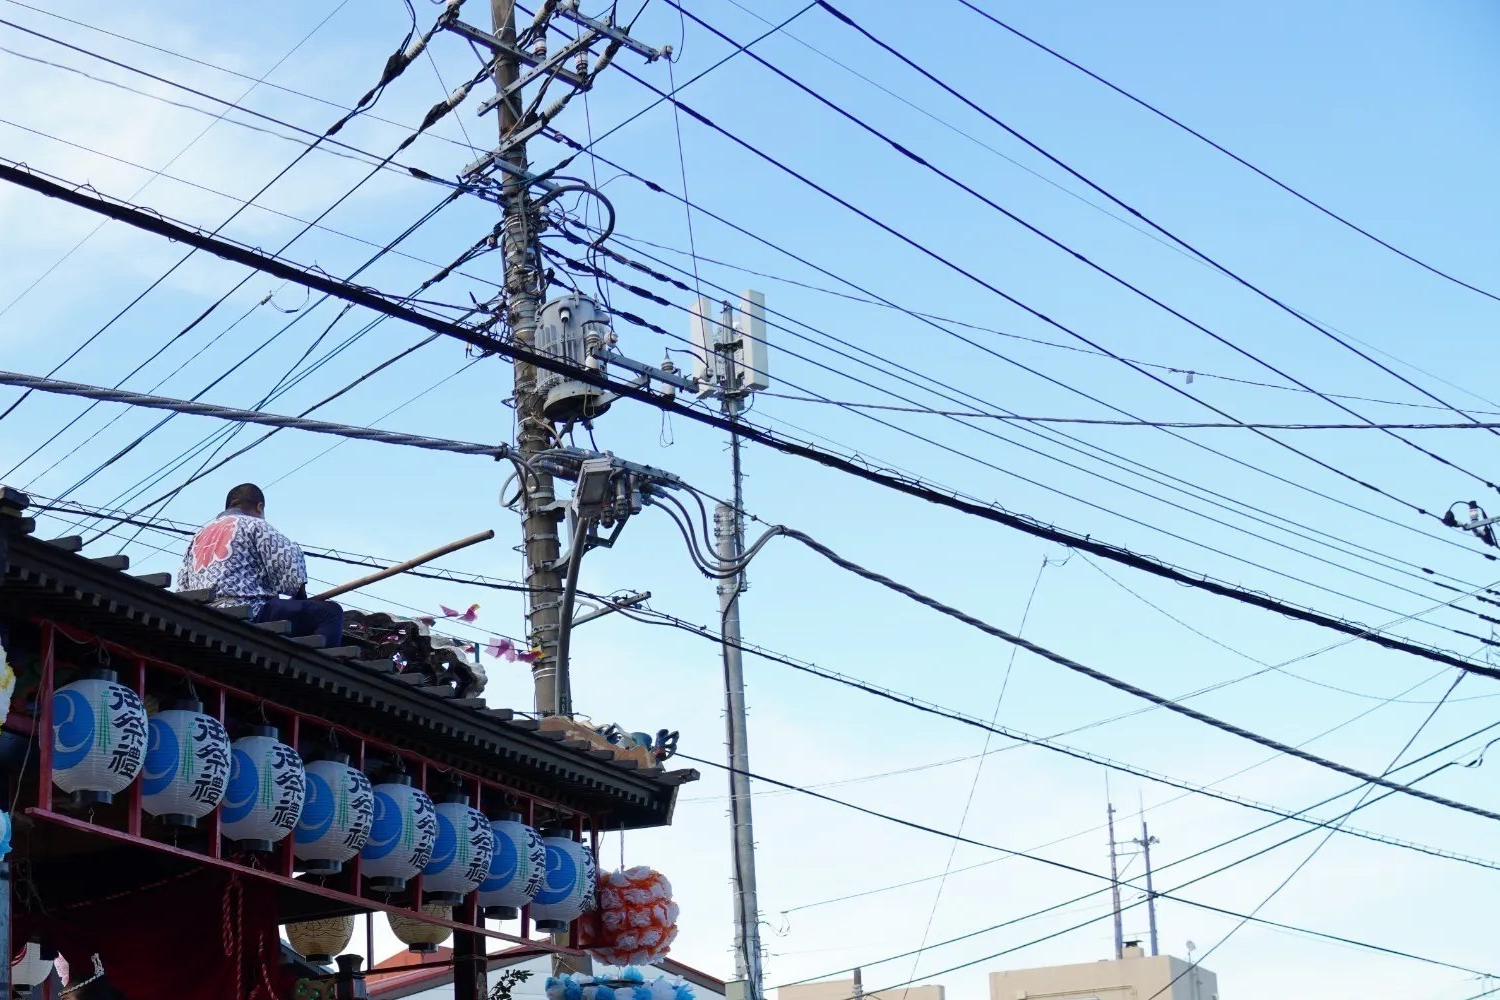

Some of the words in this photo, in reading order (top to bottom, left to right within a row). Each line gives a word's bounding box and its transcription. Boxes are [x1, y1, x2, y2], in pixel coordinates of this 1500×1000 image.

[108, 685, 148, 780] 御祭禮
[190, 717, 230, 807] 御祭禮
[270, 745, 306, 831] 御祭禮
[343, 770, 374, 851] 御祭禮
